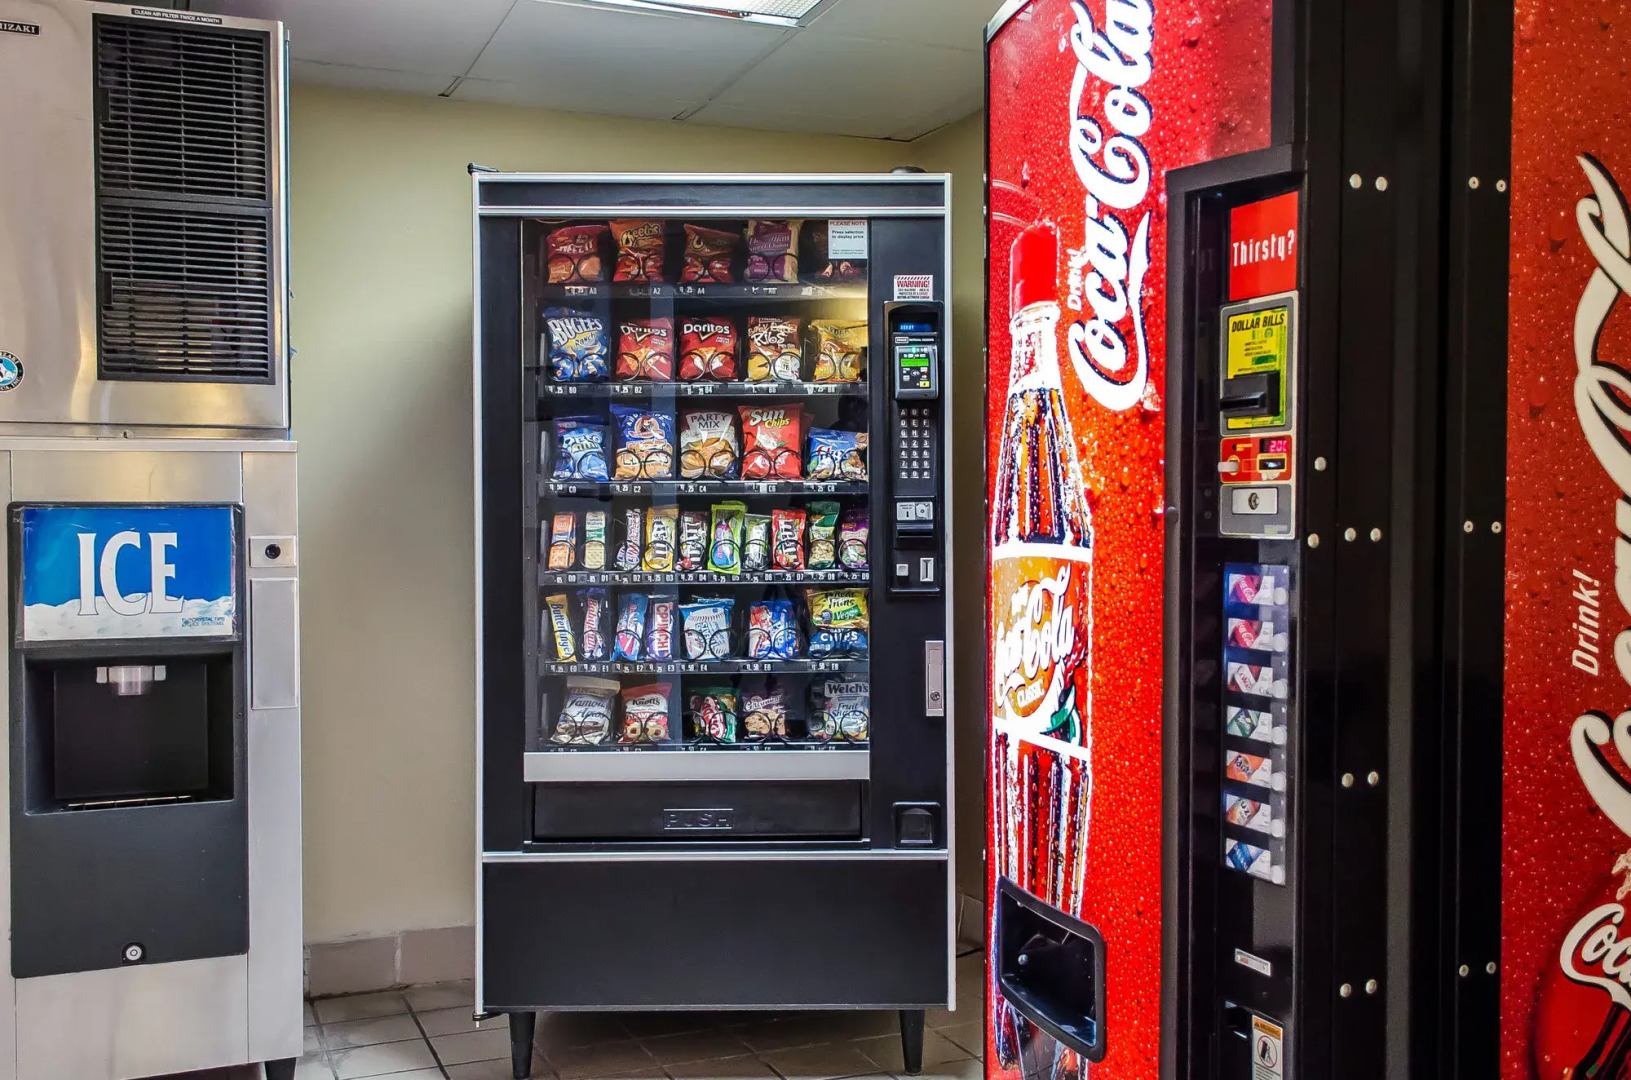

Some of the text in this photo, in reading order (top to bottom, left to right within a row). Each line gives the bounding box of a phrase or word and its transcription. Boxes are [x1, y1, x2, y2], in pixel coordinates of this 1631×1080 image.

[0, 22, 36, 33] IZAKI
[1067, 0, 1155, 411] Coca-Cola
[1233, 229, 1295, 267] Thirsty?
[896, 280, 931, 288] WARNING!
[683, 323, 731, 334] Doritos
[1232, 313, 1285, 332] DOLLAR BILLS
[548, 318, 603, 346] BUGLES
[691, 413, 729, 423] PARTY
[749, 408, 785, 427] Sun
[764, 417, 791, 430] Chips
[699, 420, 720, 429] MIX
[77, 531, 185, 617] ICE
[1572, 568, 1600, 677] Drink!
[551, 603, 573, 657] Butteringer
[700, 664, 708, 672] E4
[827, 682, 869, 695] Welch's
[838, 702, 860, 711] Fruit
